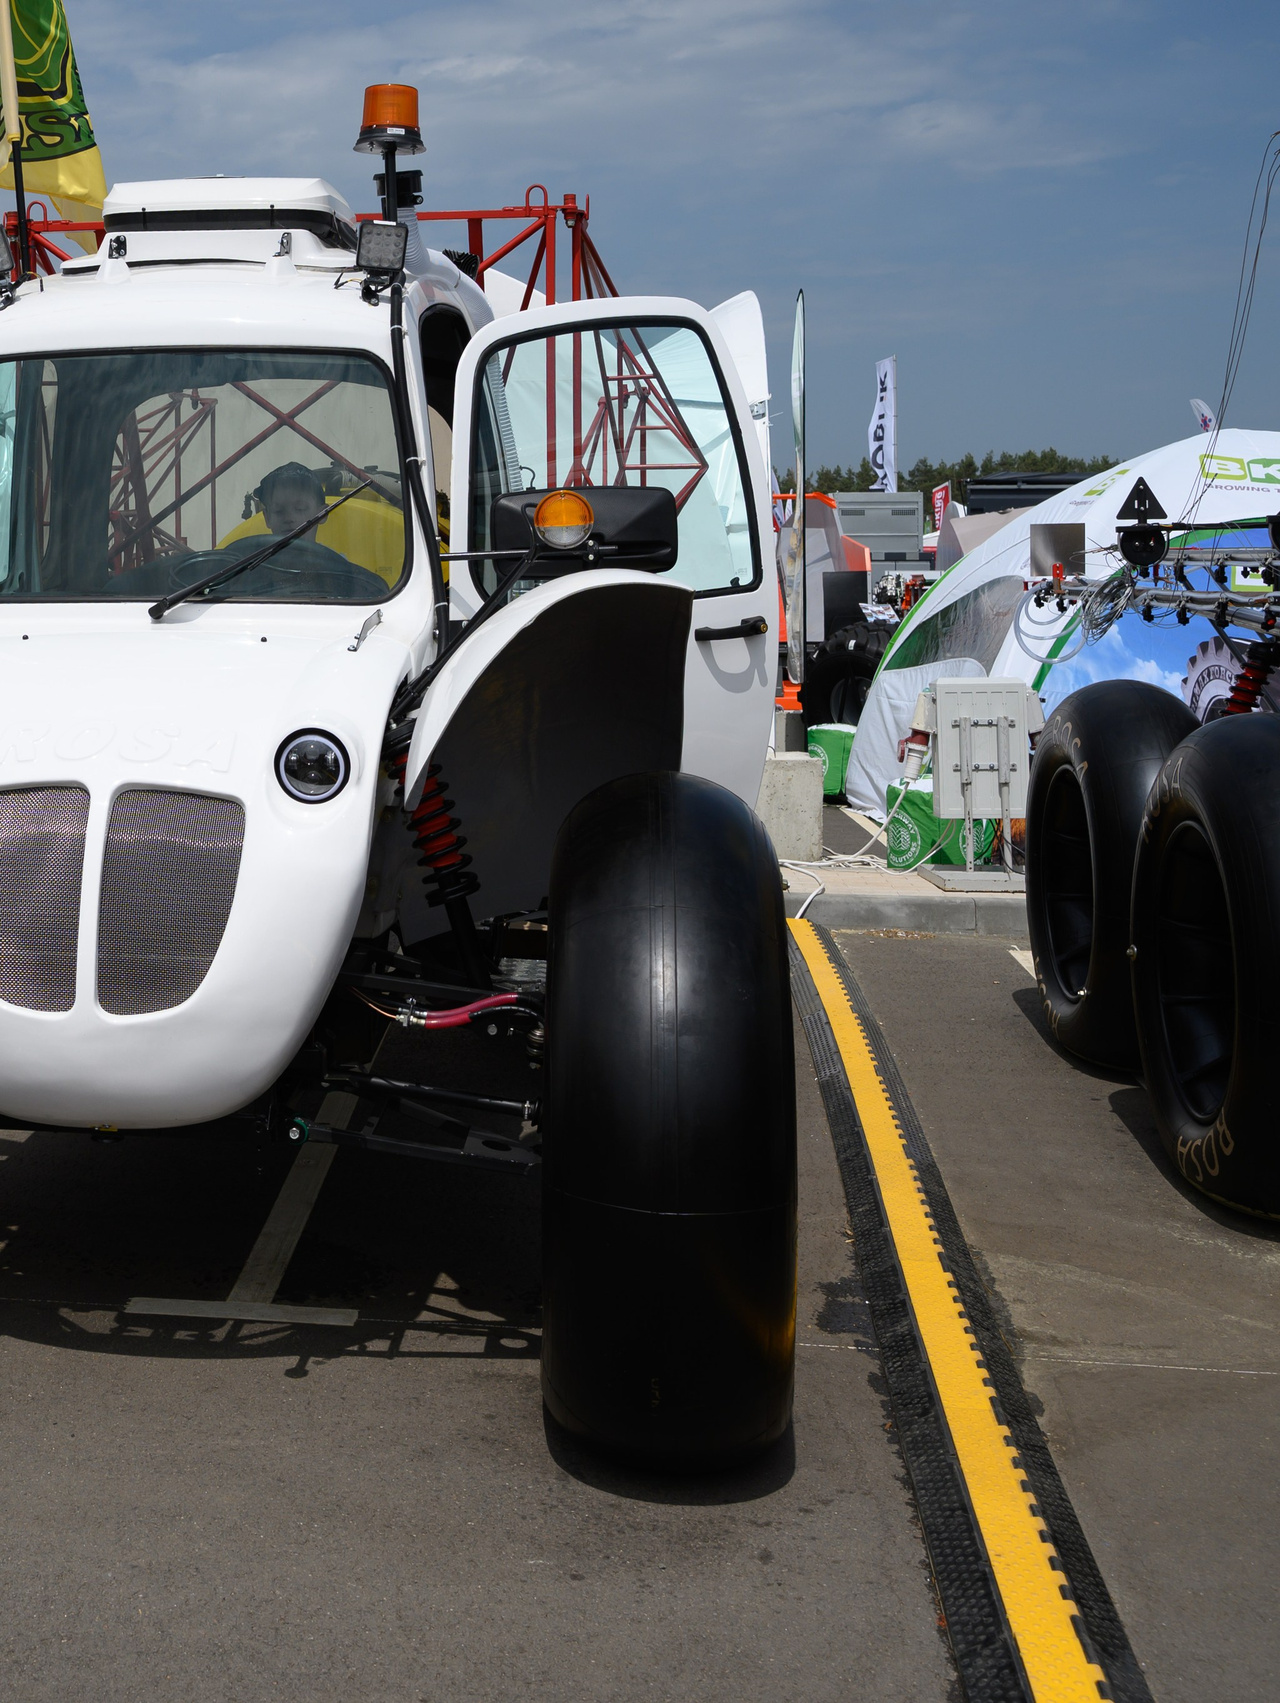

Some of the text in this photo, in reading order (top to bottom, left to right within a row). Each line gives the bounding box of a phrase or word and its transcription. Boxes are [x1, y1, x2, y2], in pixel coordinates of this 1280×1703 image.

[1204, 483, 1271, 493] GROWING
[889, 841, 918, 863] SOLUTIONS
[1177, 1106, 1235, 1183] ROSA
